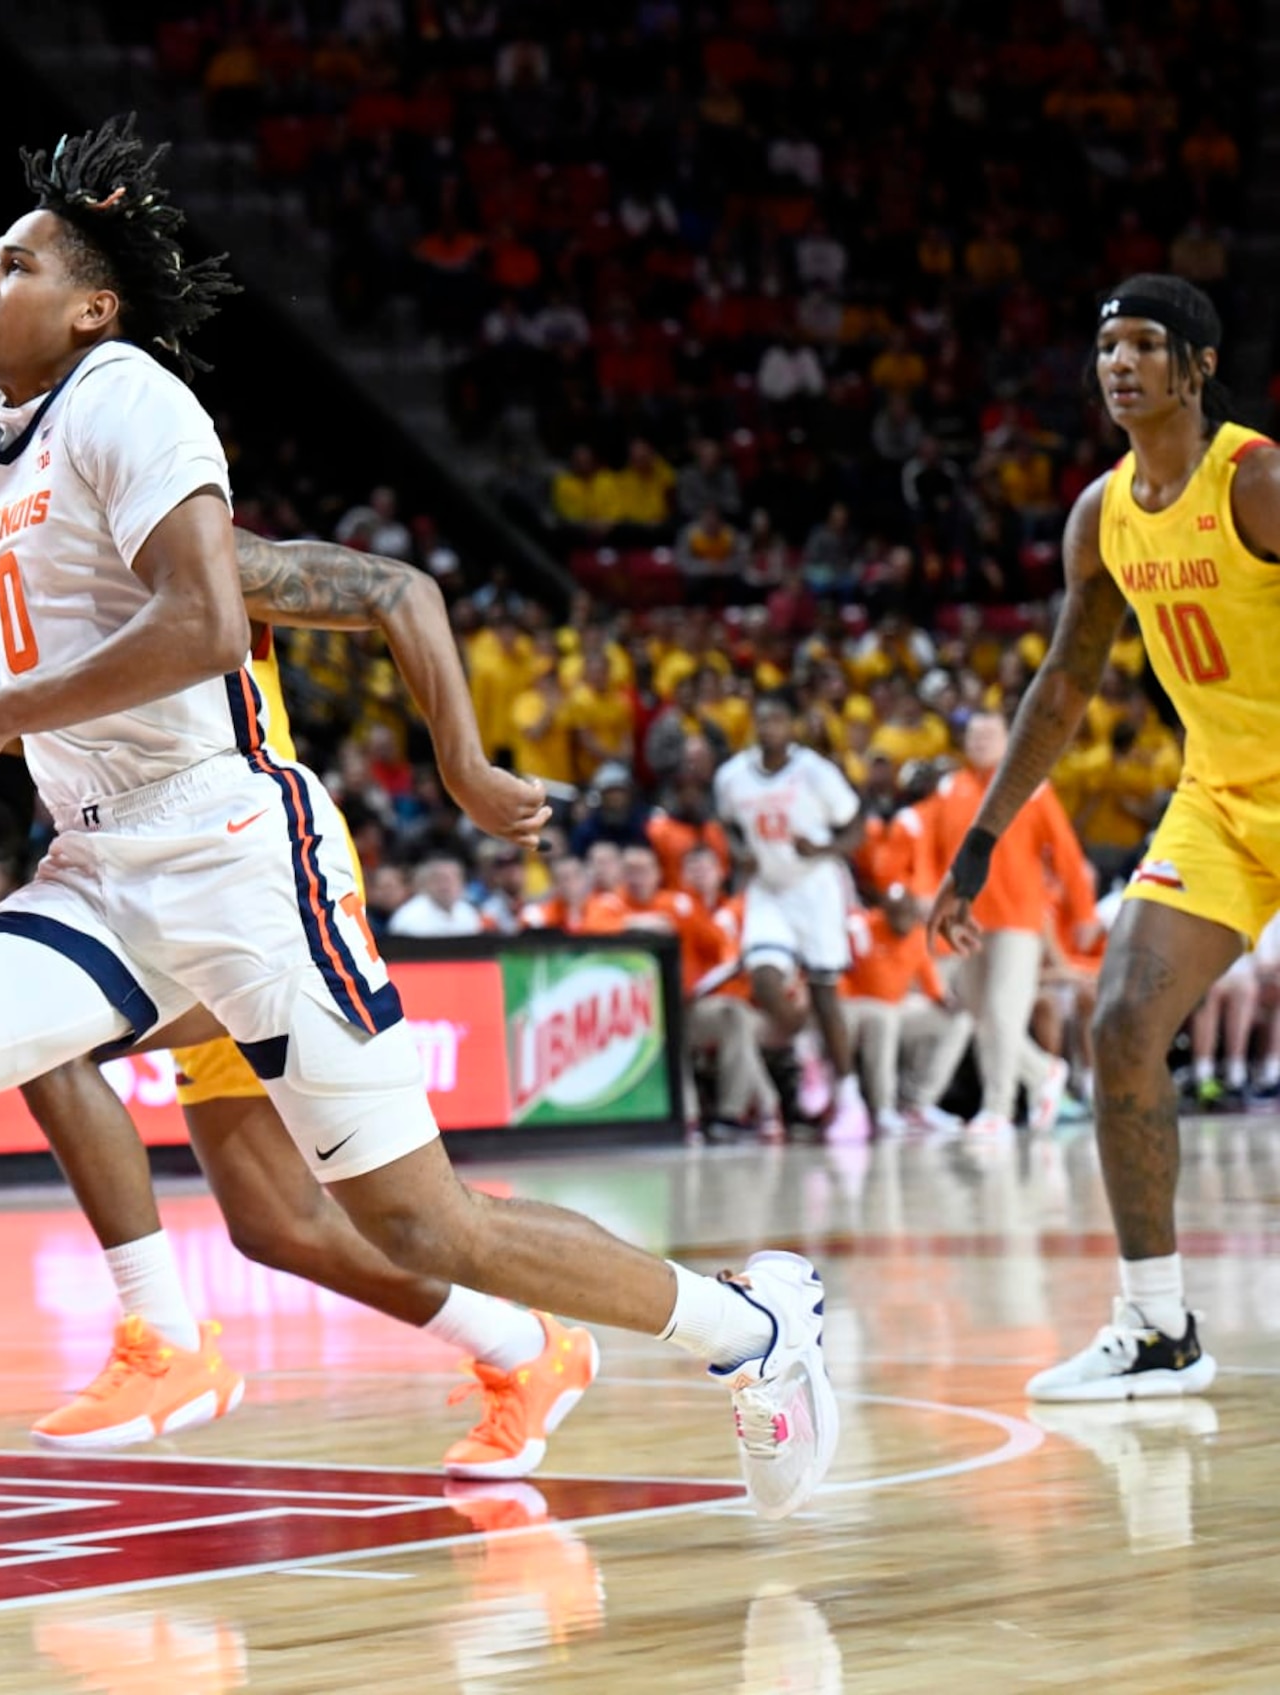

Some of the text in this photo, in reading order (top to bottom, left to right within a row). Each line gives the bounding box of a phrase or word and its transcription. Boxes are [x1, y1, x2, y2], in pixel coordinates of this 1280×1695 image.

[1121, 558, 1220, 593] MARYLAND
[1154, 602, 1231, 685] 10
[508, 970, 660, 1110] LIBMAN
